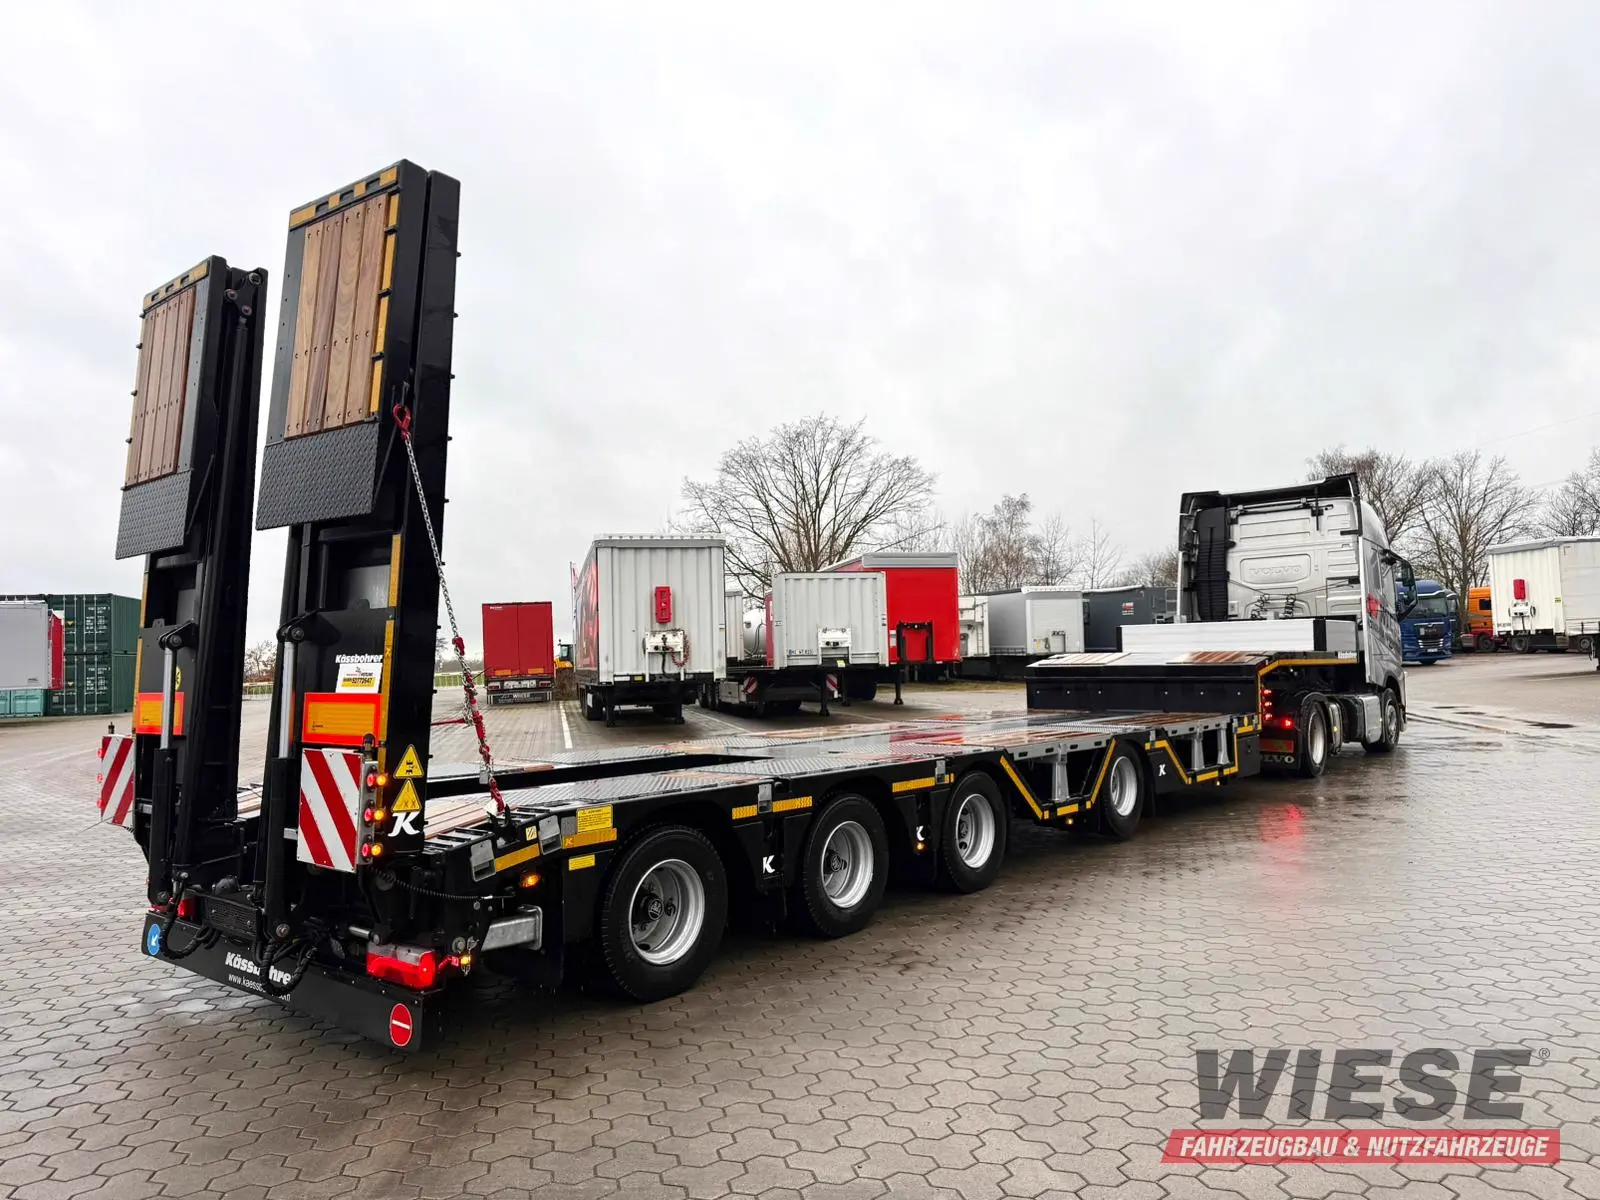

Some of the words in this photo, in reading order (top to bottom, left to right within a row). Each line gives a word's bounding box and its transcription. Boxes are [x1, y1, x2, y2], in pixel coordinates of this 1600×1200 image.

[1248, 564, 1302, 575] VOLVO
[335, 653, 384, 664] Kässbohrer
[762, 854, 776, 874] K
[225, 951, 293, 985] Kässhre
